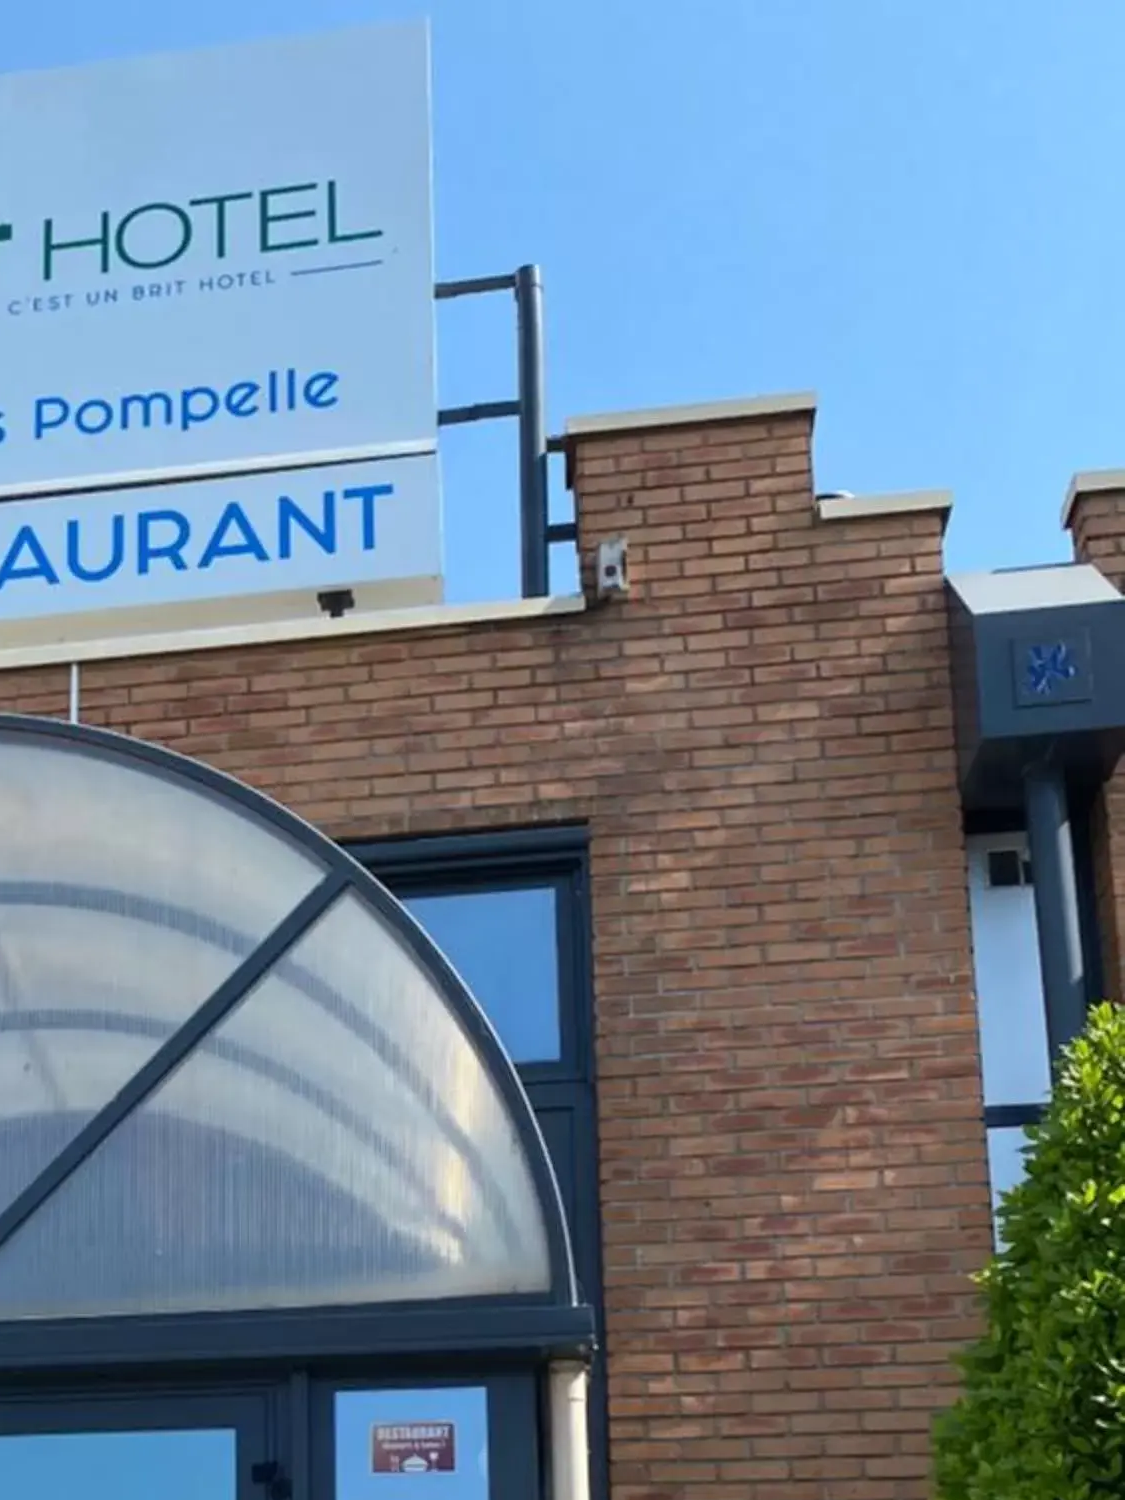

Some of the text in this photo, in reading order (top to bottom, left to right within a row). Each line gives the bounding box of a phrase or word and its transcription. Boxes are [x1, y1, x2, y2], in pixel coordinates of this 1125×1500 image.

[43, 180, 383, 281] HOTEL
[7, 293, 74, 316] C'EST
[86, 289, 118, 306] UN
[132, 280, 187, 301] BRIT
[199, 270, 276, 291] HOTEL
[34, 368, 340, 439] Pompelle
